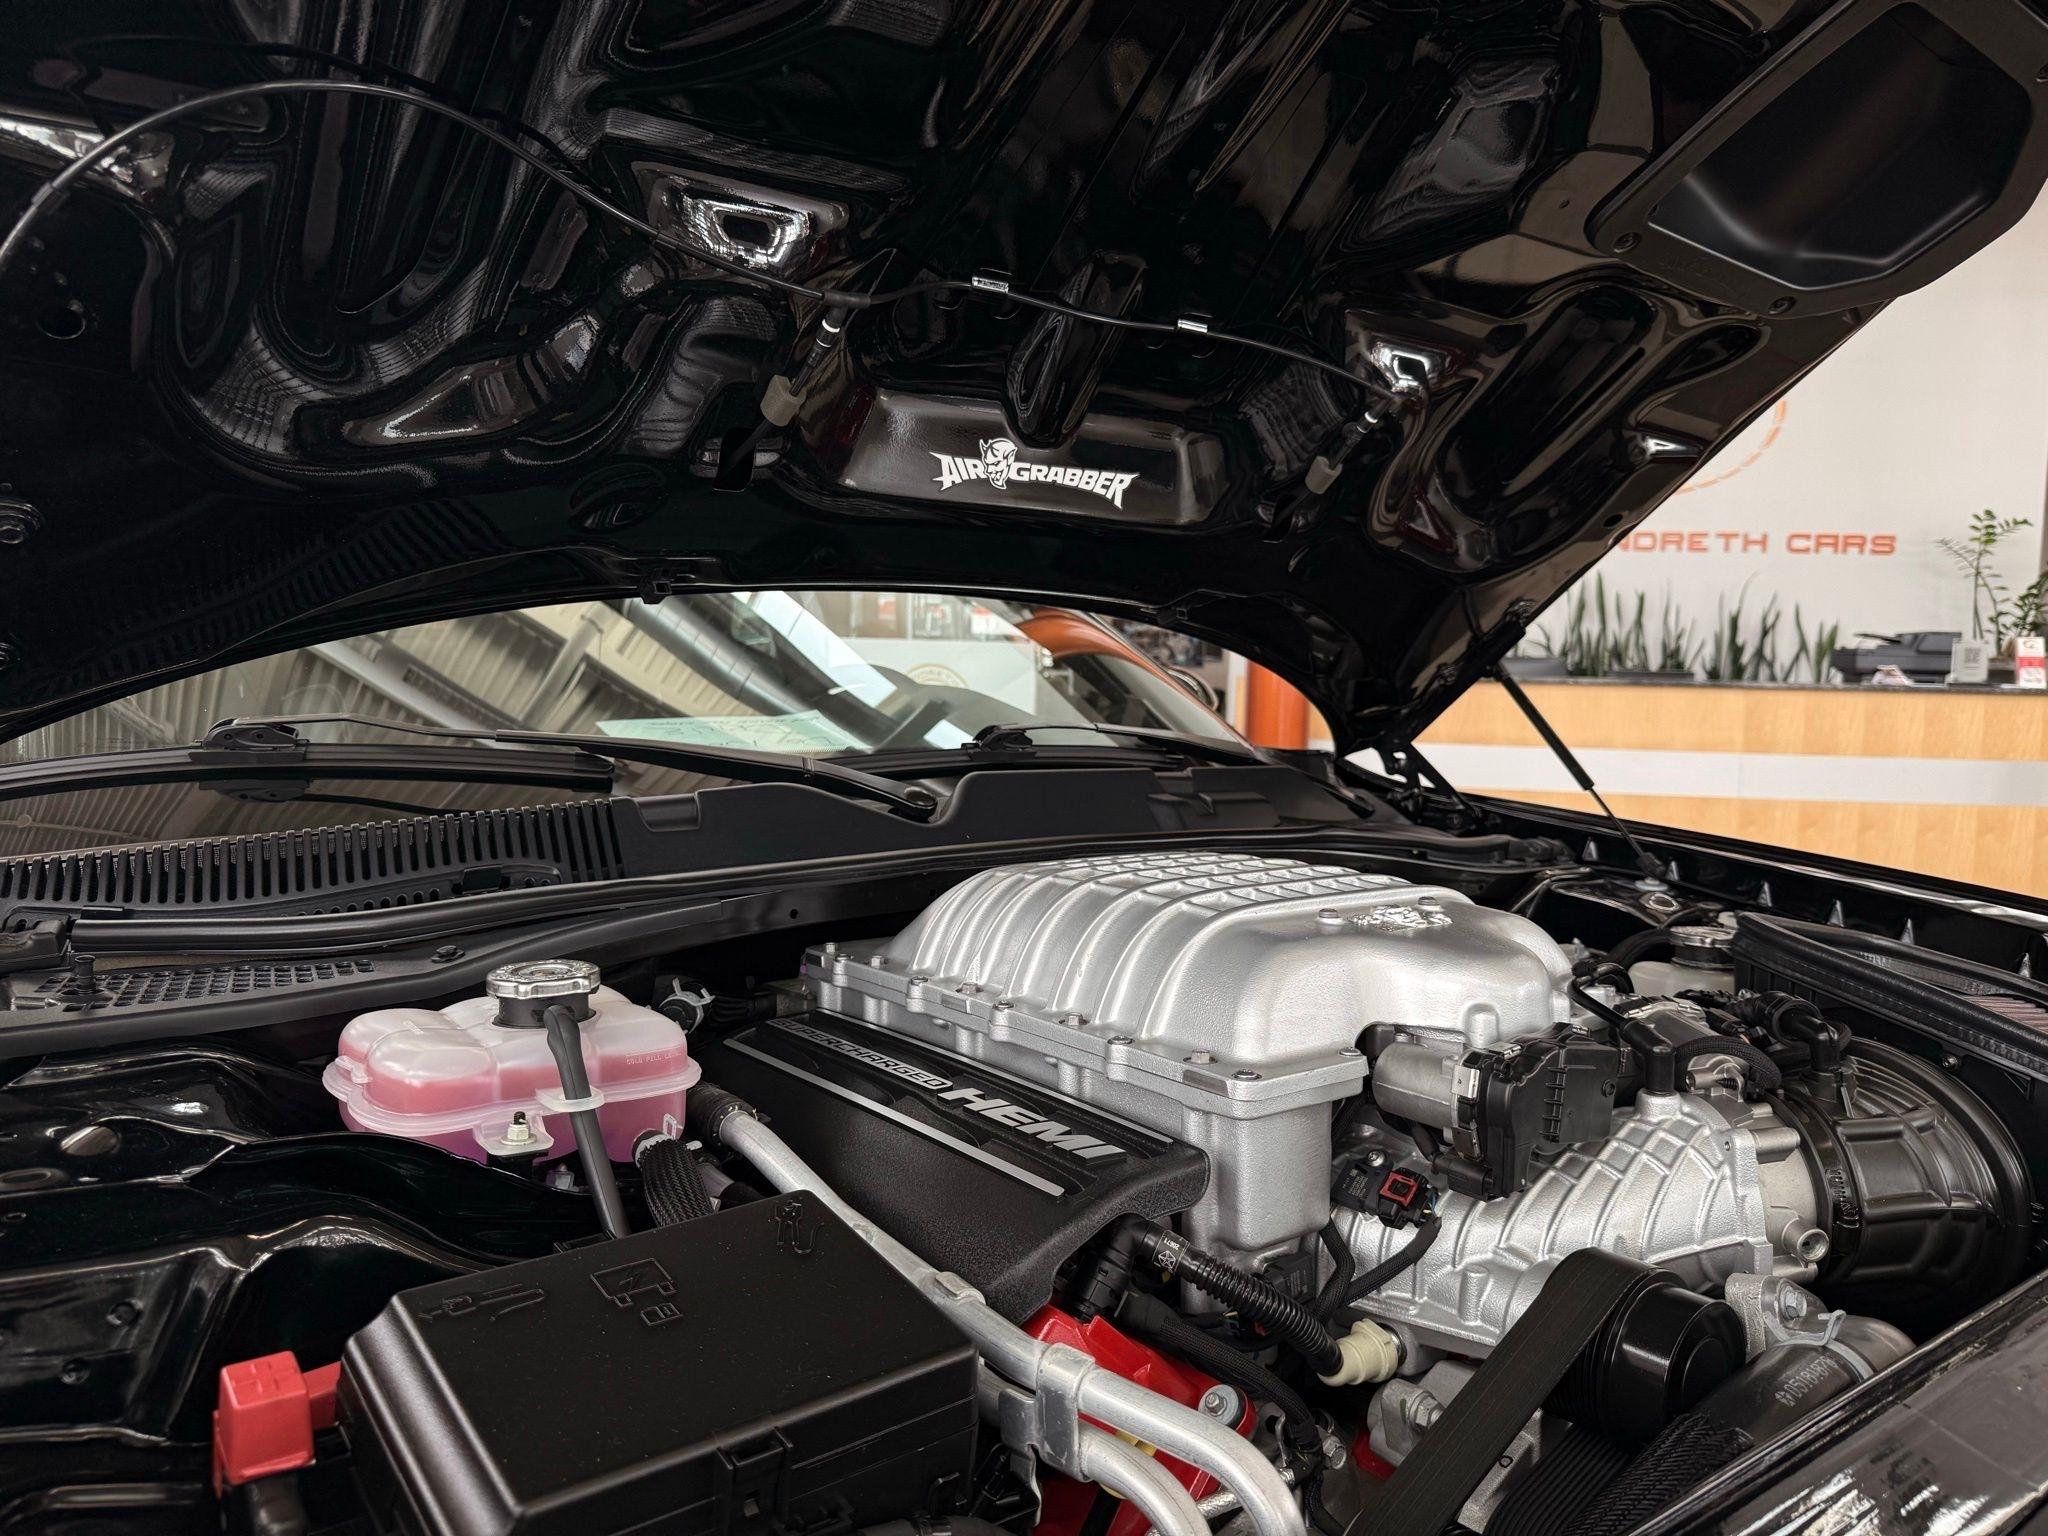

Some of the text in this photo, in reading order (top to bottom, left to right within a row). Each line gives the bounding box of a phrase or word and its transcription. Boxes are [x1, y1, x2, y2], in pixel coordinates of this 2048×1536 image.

[929, 451, 1141, 510] AIR GRABBER
[1785, 532, 1897, 556] CARS
[770, 1018, 950, 1088] SUPERCHARGED
[938, 1087, 1126, 1160] HEMI
